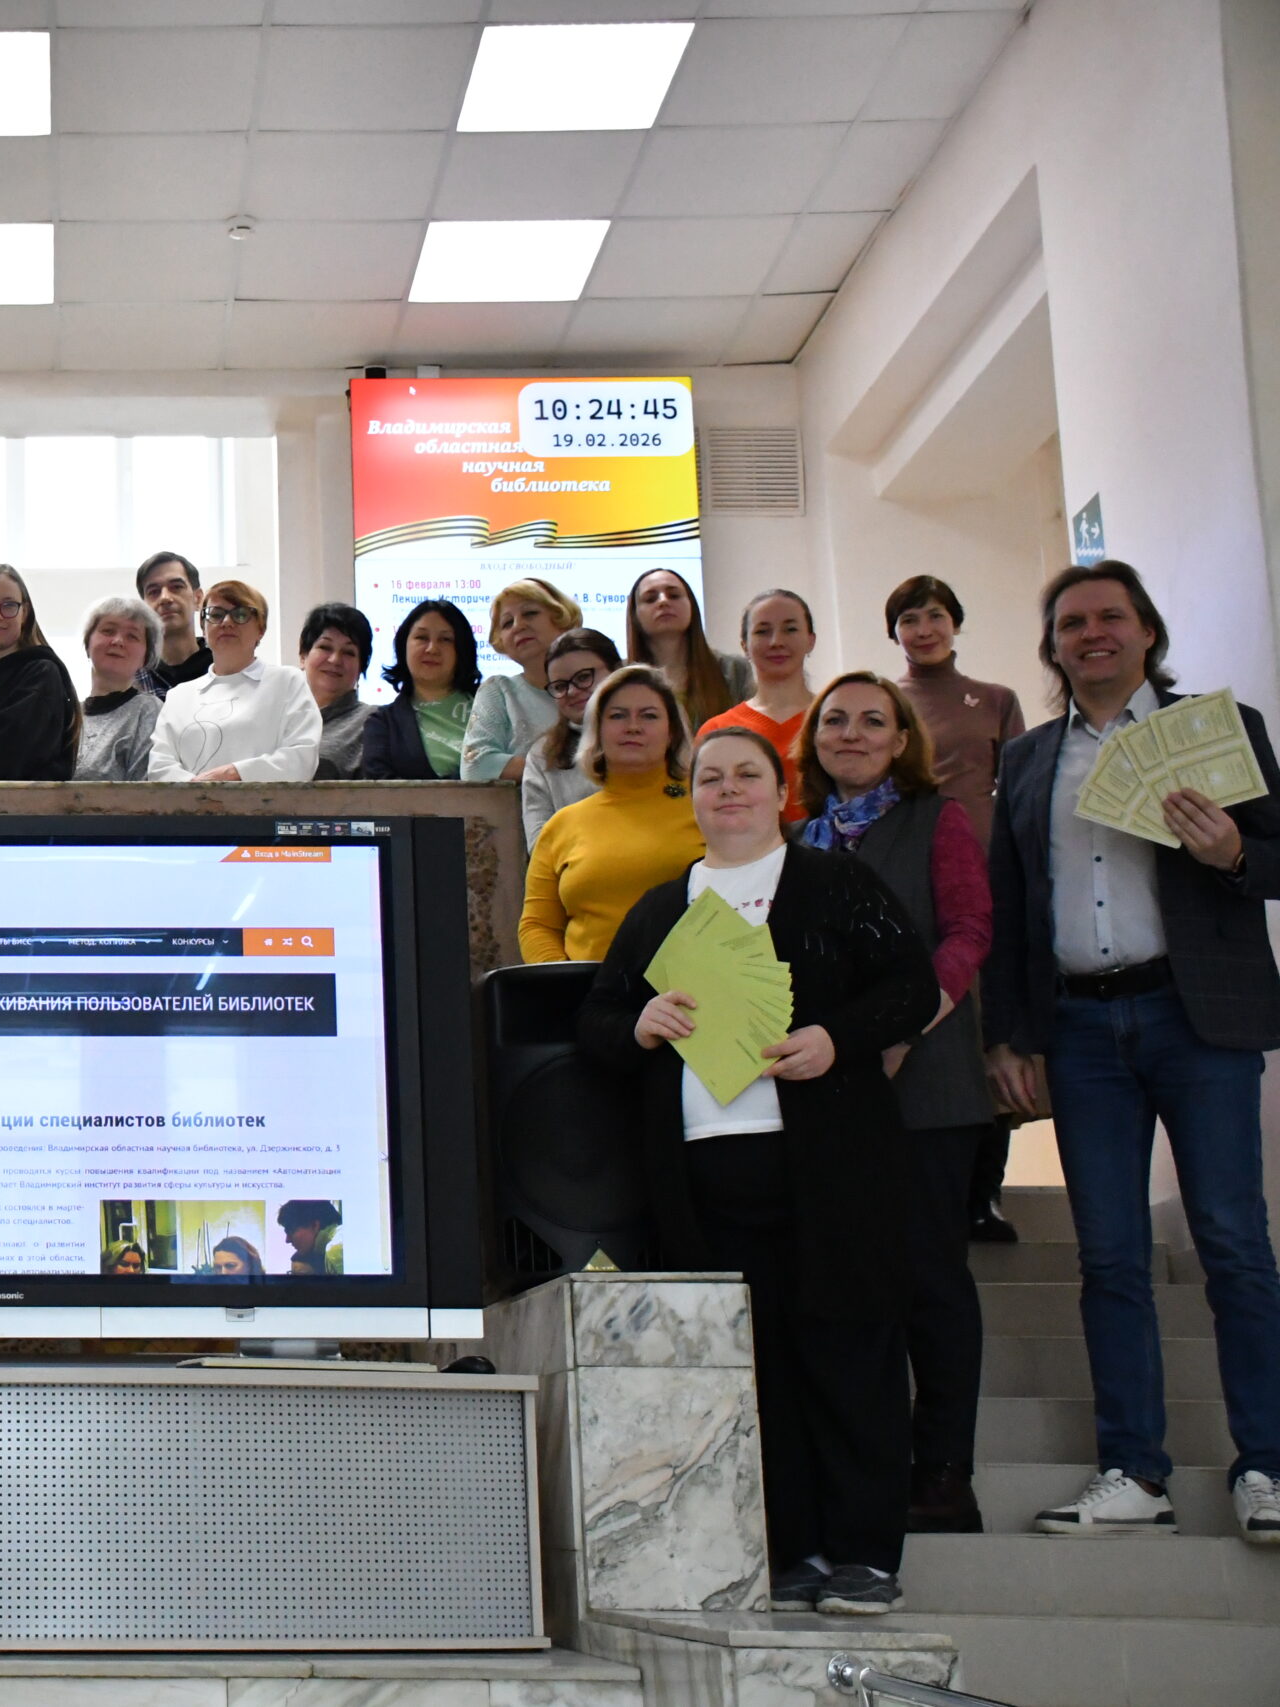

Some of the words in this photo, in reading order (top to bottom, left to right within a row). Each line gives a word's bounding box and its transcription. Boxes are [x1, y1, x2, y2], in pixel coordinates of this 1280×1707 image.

[534, 399, 678, 420] 10:24:45
[367, 419, 511, 438] Владимирская
[414, 438, 524, 454] областная
[553, 433, 662, 448] 19.02.2026
[462, 460, 545, 475] научная
[490, 477, 611, 492] библиотека
[391, 580, 402, 590] 16
[406, 580, 451, 591] февраля
[455, 580, 481, 589] 13:00
[254, 850, 273, 859] Вход
[280, 849, 324, 858] MainStream
[77, 993, 213, 1012] ПОЛЬЗОВАТЕЛЕЙ
[218, 996, 315, 1011] БИБЛИОТЕК
[40, 1115, 166, 1131] специалистов
[171, 1111, 266, 1128] библиотек
[48, 1145, 109, 1154] Владимирская
[111, 1144, 154, 1152] областная
[157, 1146, 191, 1154] научная
[193, 1144, 245, 1154] библиотека,
[55, 1168, 81, 1176] курсы
[137, 1167, 200, 1177] квалификации
[203, 1168, 219, 1176] под
[19, 1180, 81, 1190] Владимирский
[84, 1182, 121, 1190] институт
[123, 1182, 162, 1190] развития
[164, 1181, 191, 1190] сферы
[194, 1182, 232, 1190] культуры
[46, 1241, 86, 1249] развитии
